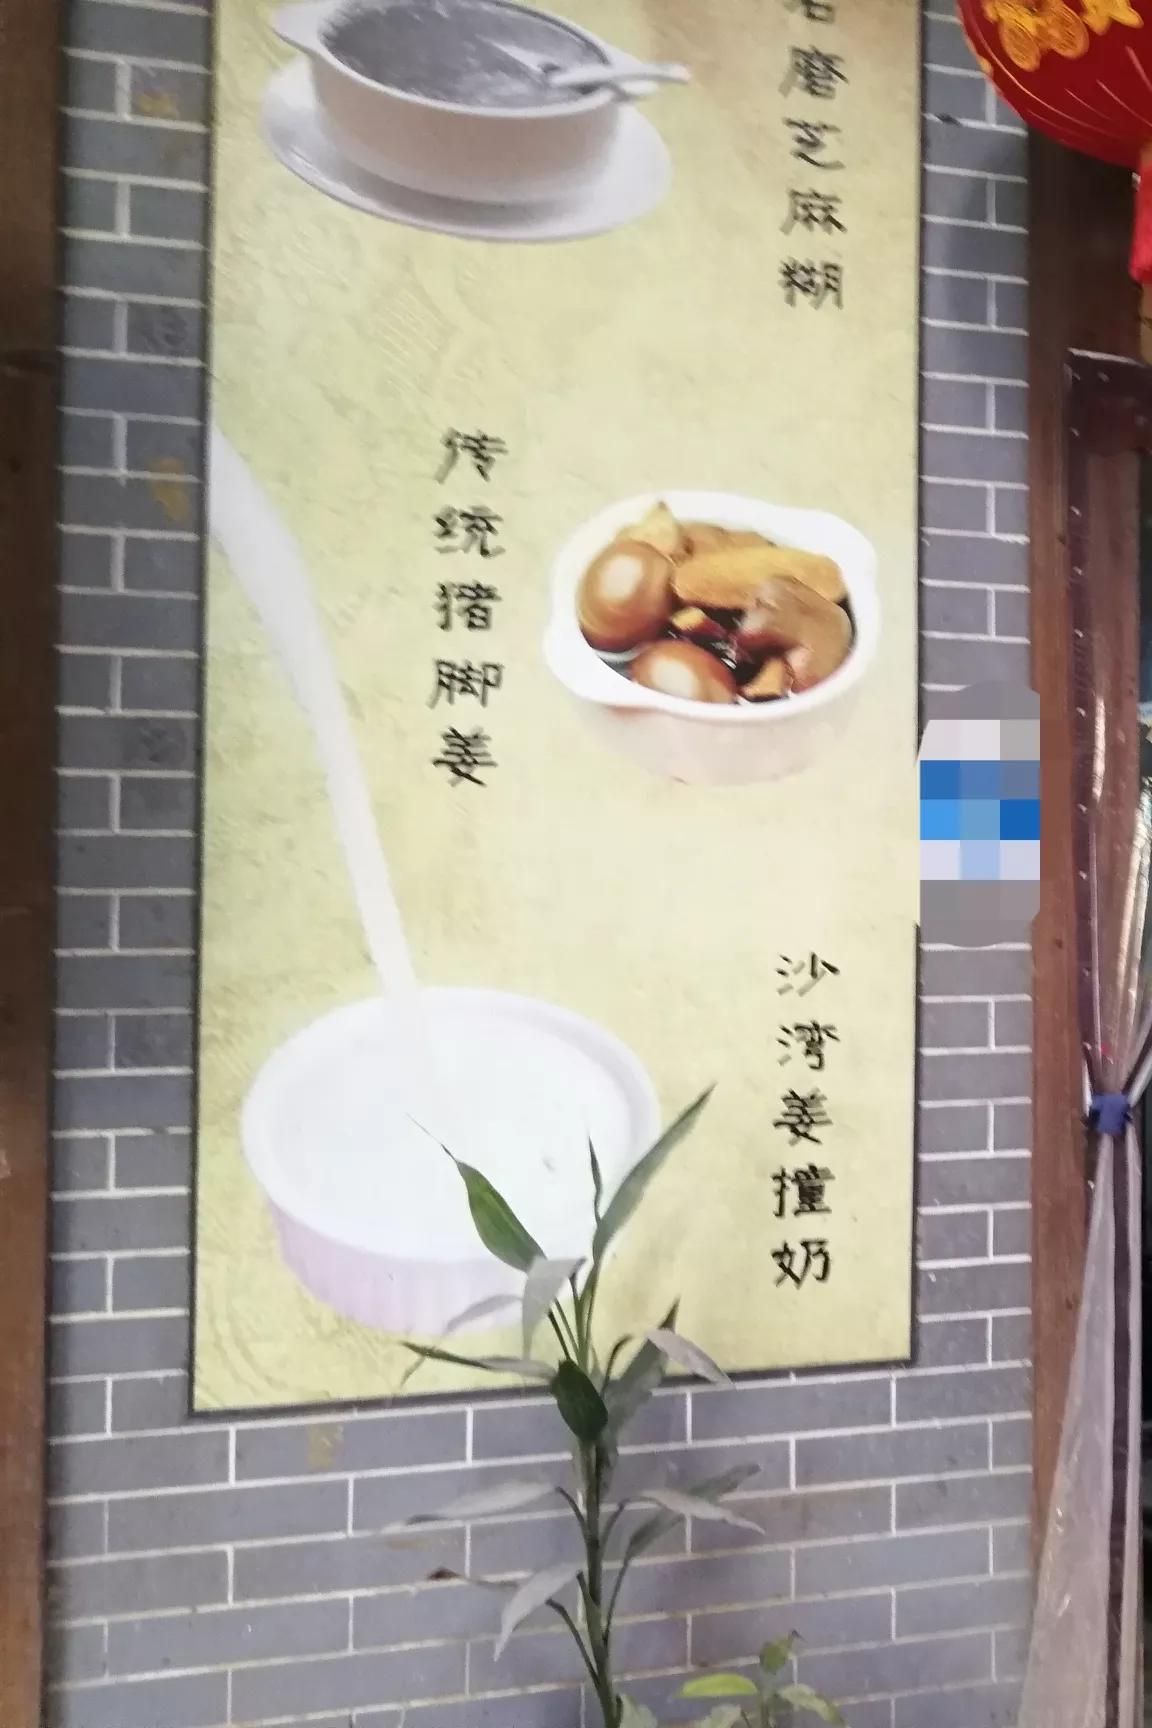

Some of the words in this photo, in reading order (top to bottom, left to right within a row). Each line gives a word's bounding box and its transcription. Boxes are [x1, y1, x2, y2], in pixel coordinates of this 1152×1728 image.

[426, 427, 508, 788] 传统猪脚姜
[771, 951, 840, 1289] 沙湾姜撞奶
